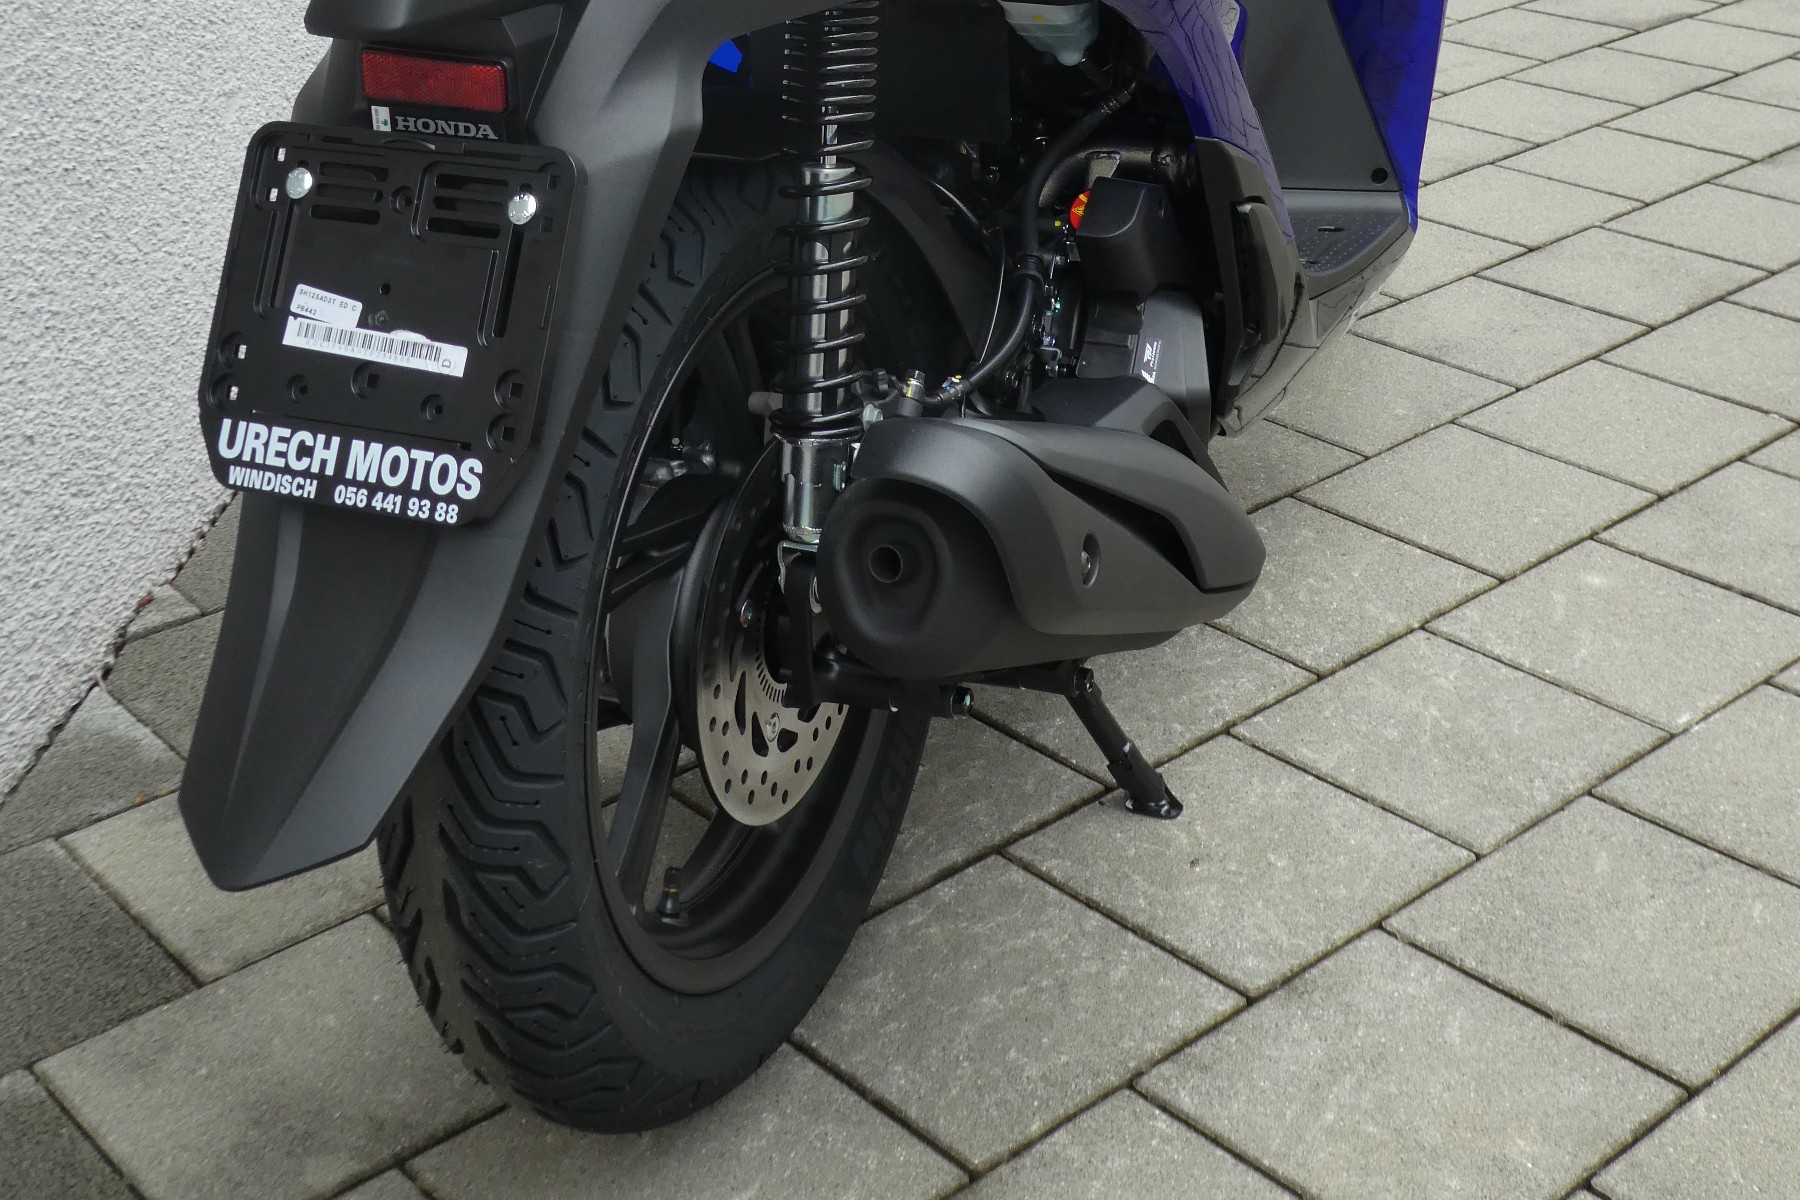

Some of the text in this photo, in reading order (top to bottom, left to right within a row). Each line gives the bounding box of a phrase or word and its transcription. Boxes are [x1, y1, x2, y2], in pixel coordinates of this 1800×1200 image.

[395, 116, 499, 140] HONDA
[339, 300, 349, 310] ED
[441, 358, 451, 368] D
[218, 418, 483, 500] URECH MOTOS
[228, 465, 458, 524] WINDISCH 056 441 93 88
